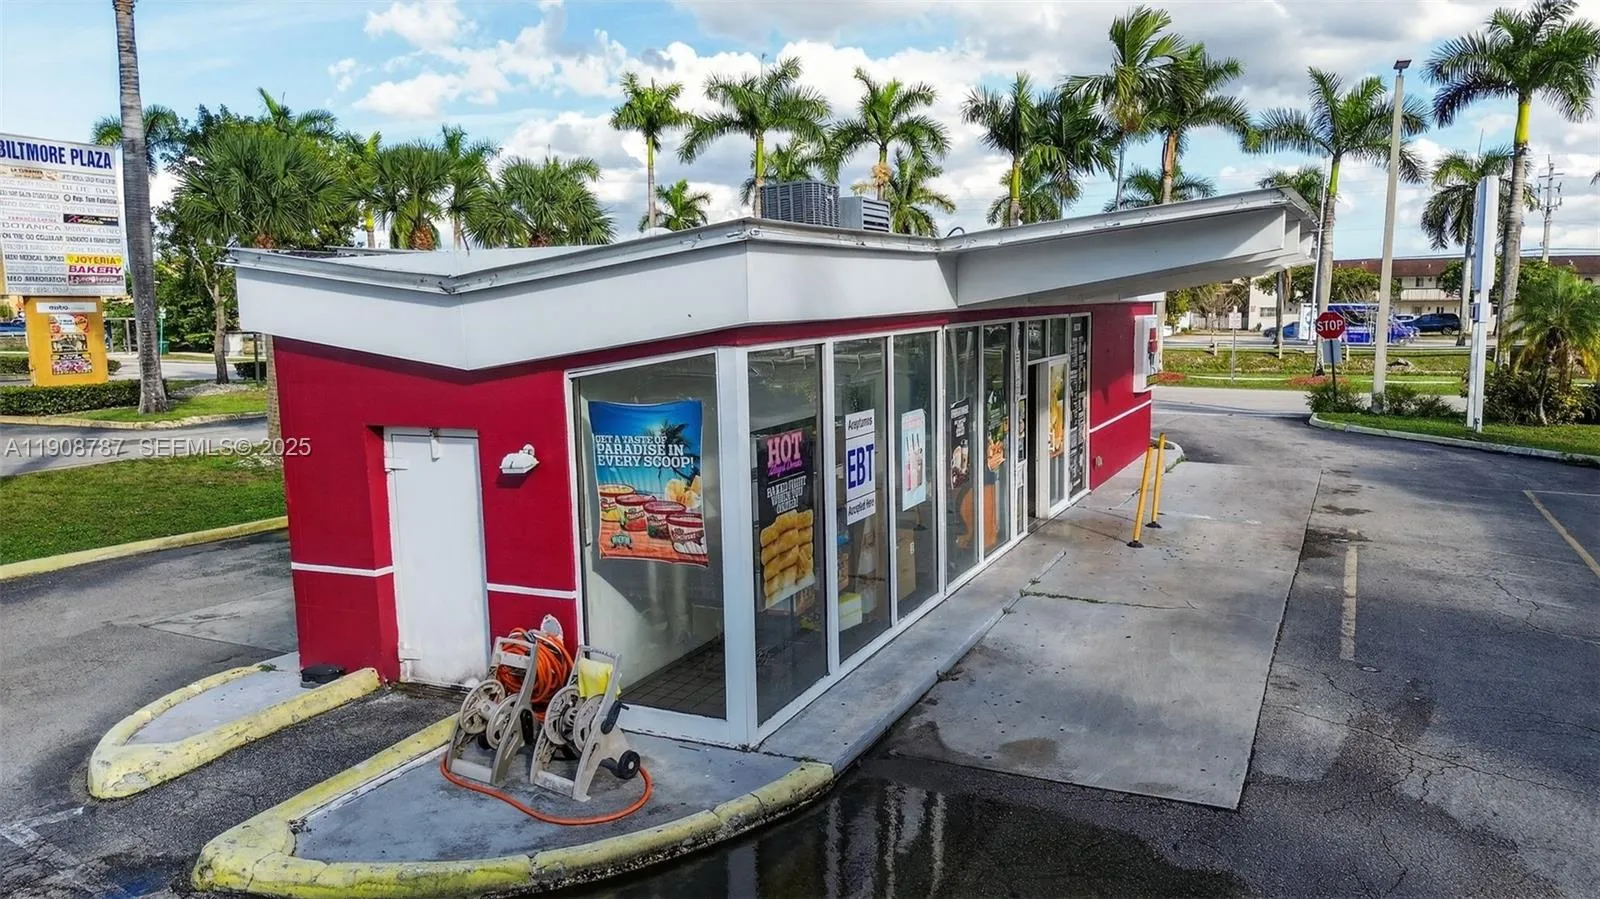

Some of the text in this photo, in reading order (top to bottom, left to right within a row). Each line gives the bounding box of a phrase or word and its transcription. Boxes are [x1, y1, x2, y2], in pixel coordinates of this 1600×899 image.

[0, 140, 113, 169] BILTMORE PLAZA
[74, 255, 116, 265] JOYERIA
[69, 265, 121, 274] BAKERY
[1316, 319, 1343, 332] STOP
[595, 435, 668, 445] GET A TASTE OF
[596, 443, 685, 457] PARADISE IN
[767, 431, 803, 468] HOT
[597, 454, 694, 469] EVERY SCOOP!
[847, 443, 875, 489] EBT
